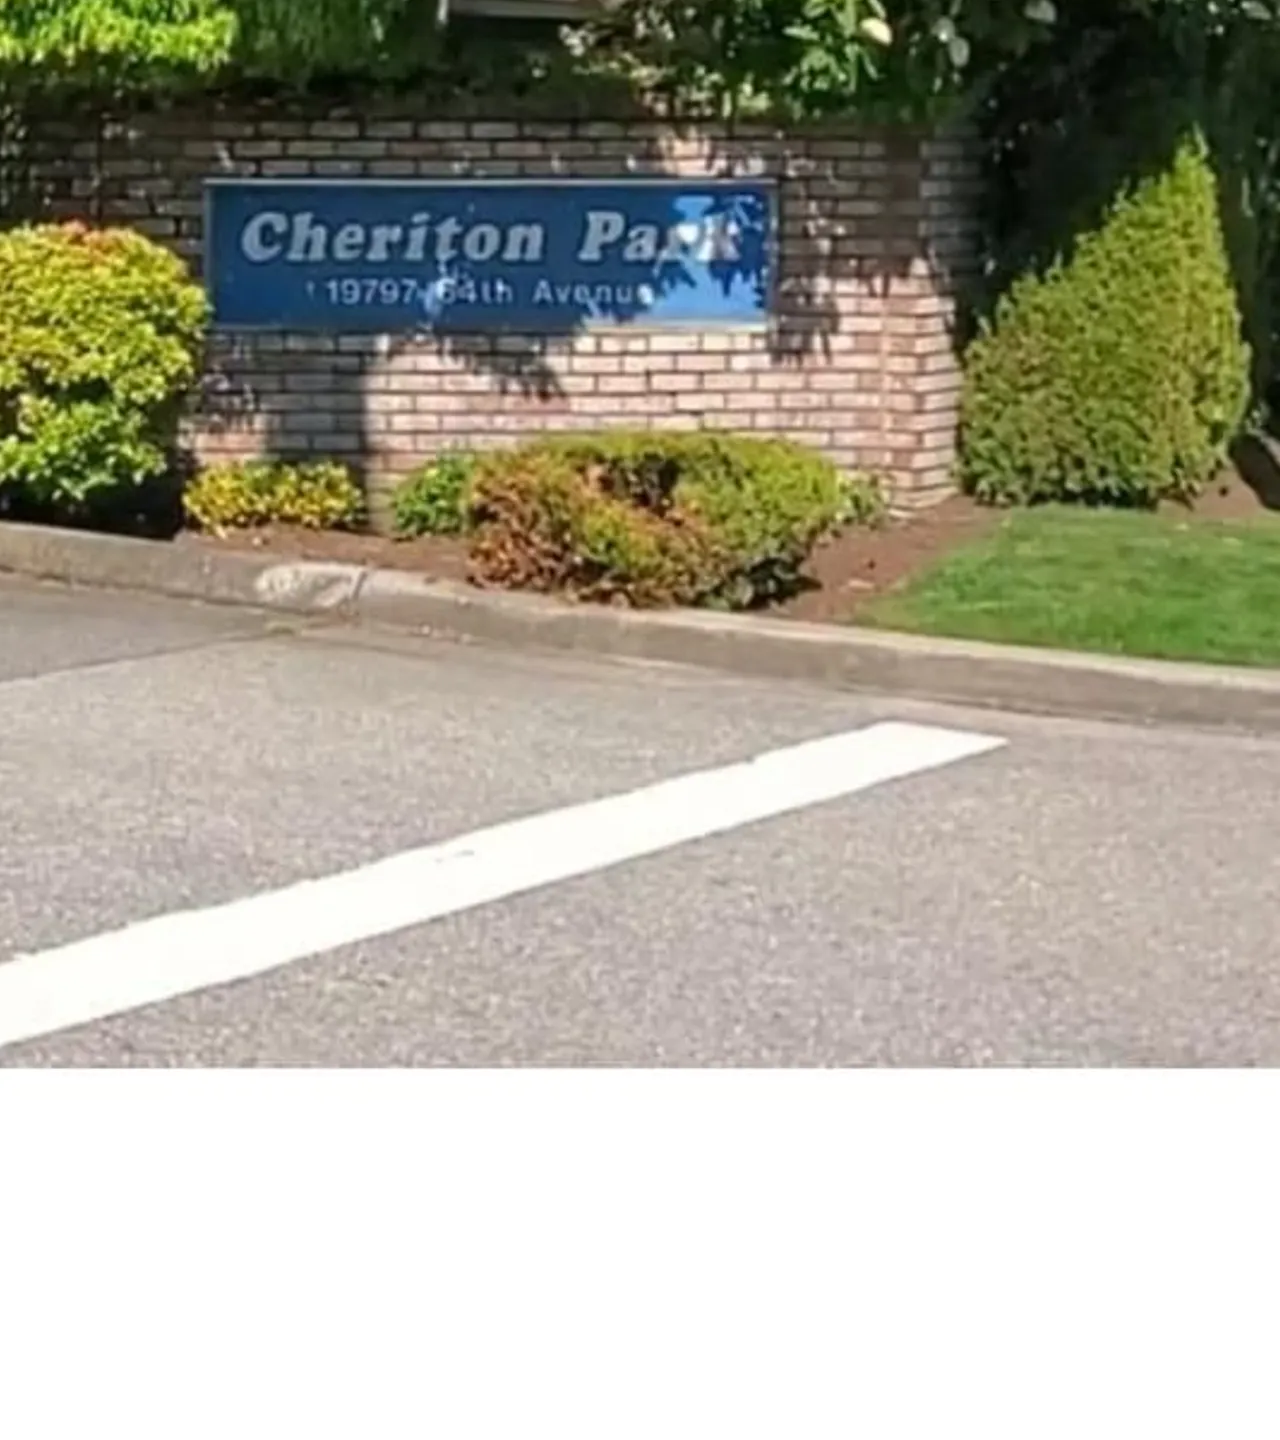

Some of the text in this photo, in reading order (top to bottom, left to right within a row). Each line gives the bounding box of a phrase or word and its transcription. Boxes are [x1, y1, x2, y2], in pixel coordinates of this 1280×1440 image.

[242, 211, 741, 261] Cheriton Park
[326, 278, 418, 305] 19797
